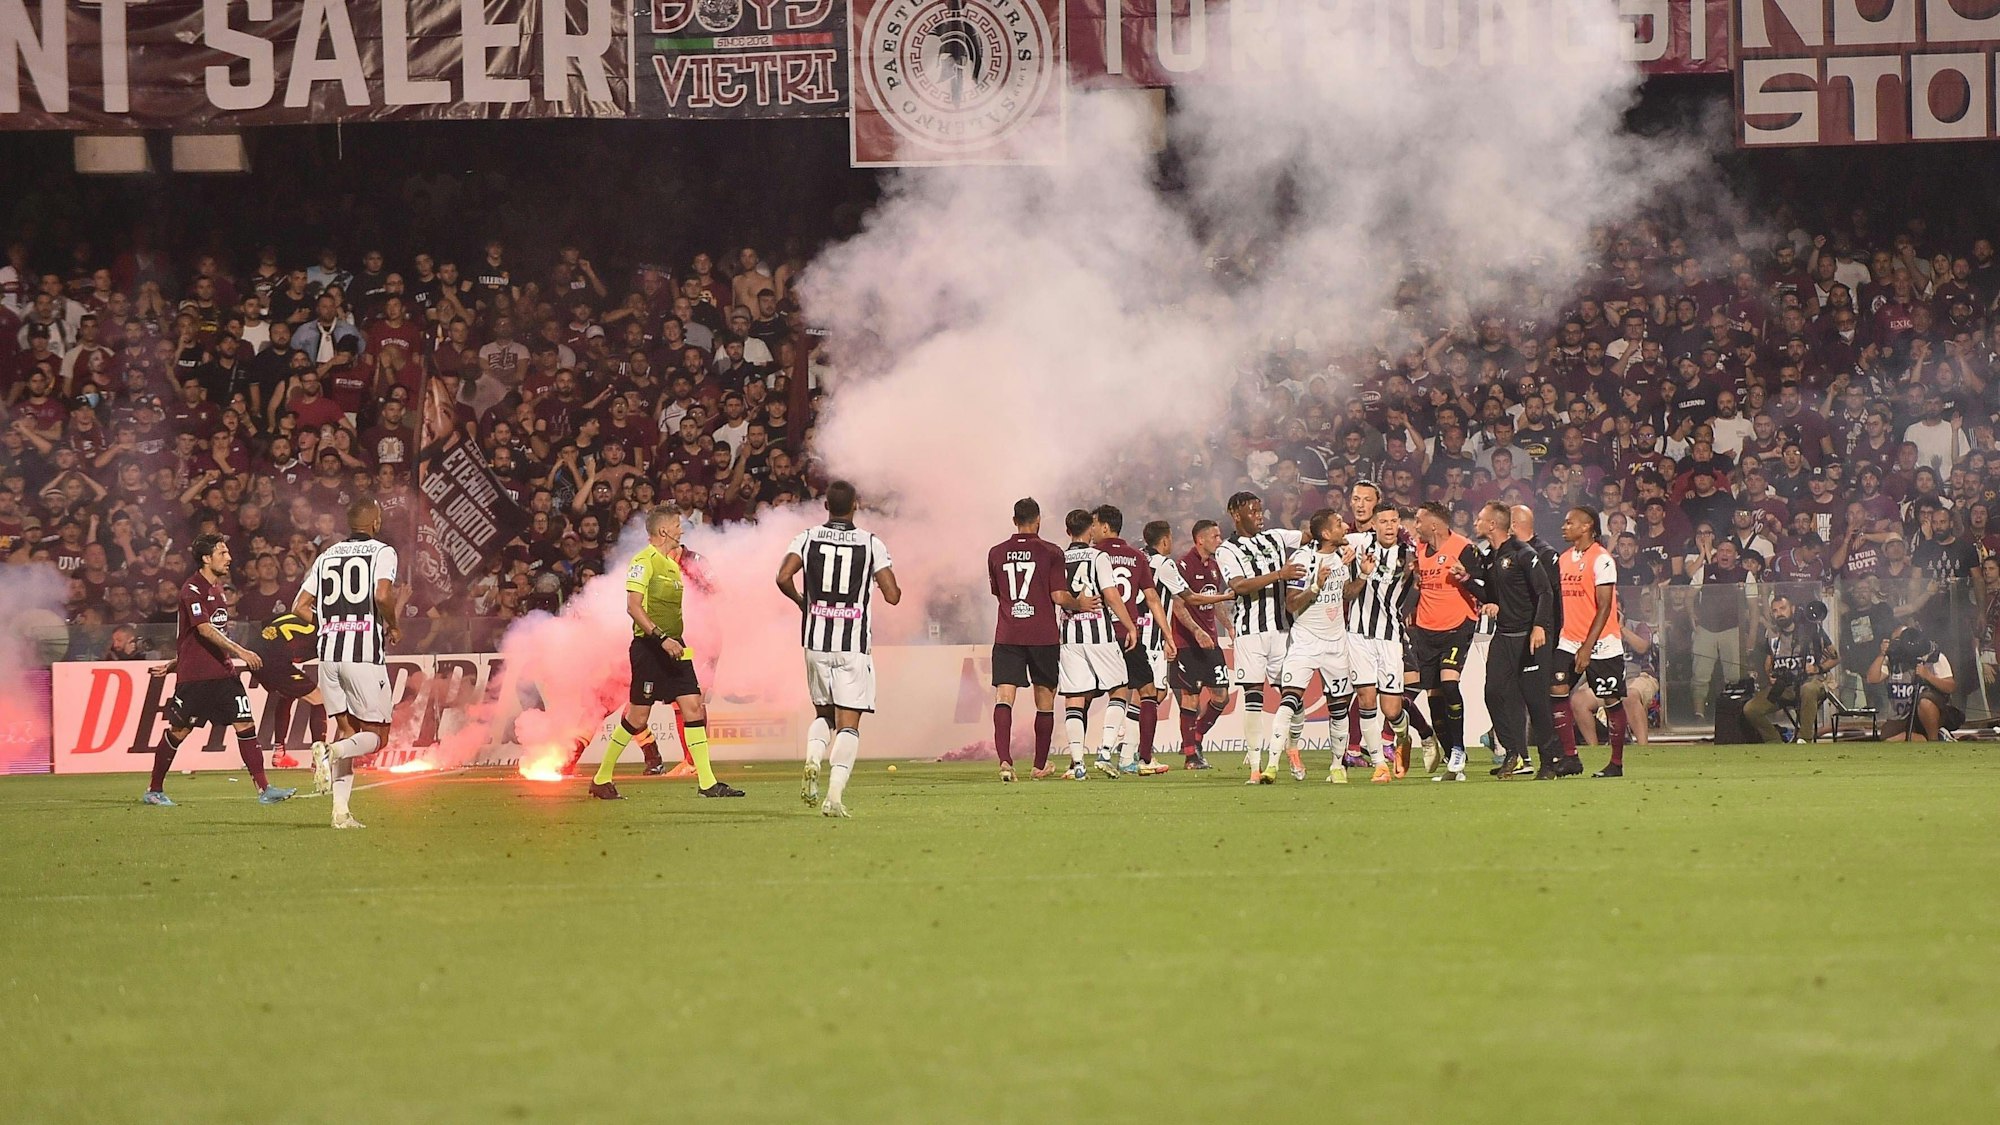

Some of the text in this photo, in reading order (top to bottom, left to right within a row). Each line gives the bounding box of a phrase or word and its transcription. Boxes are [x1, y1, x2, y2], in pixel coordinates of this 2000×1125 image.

[652, 49, 840, 108] VIETRI
[1743, 52, 2000, 144] STO
[817, 530, 858, 542] WALACE
[1006, 550, 1032, 562] FAZIO
[819, 543, 853, 595] 11
[321, 556, 370, 606] 50
[1002, 561, 1037, 601] 17
[1332, 676, 1348, 694] 37
[1385, 673, 1396, 690] 2
[1595, 676, 1618, 692] 22
[235, 695, 251, 713] 10
